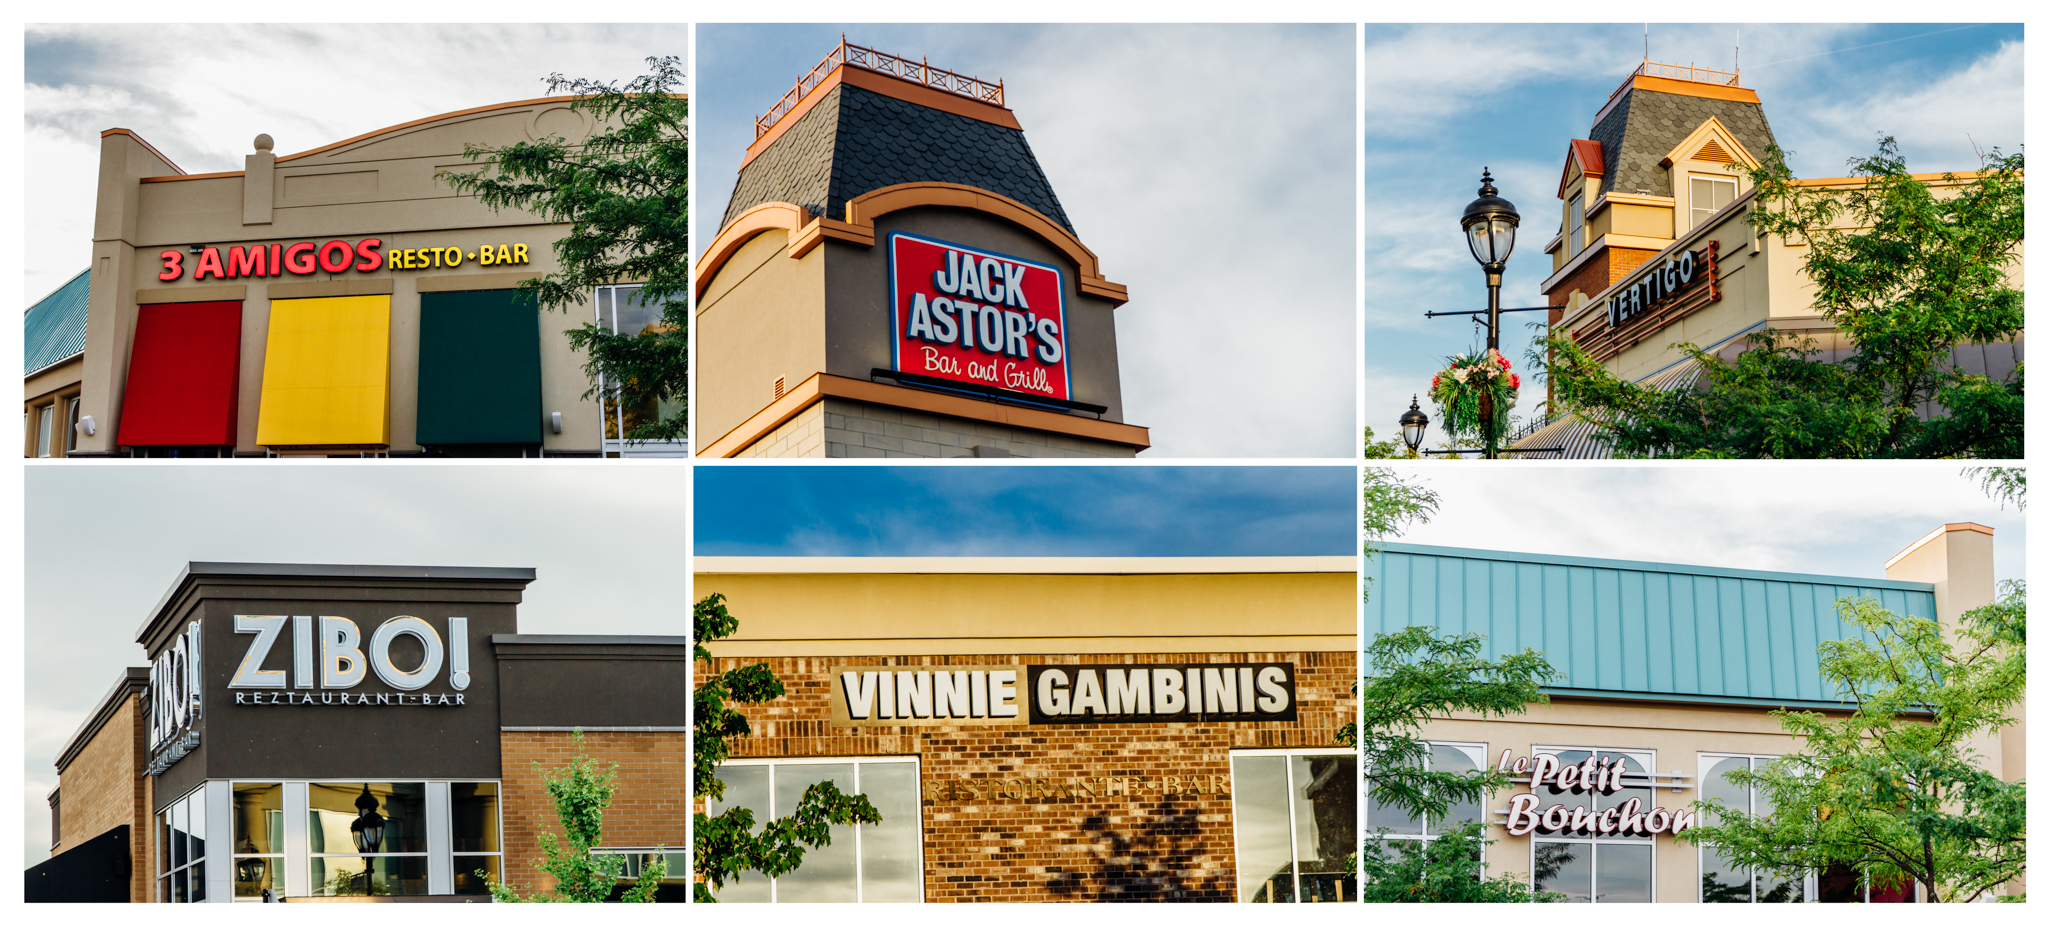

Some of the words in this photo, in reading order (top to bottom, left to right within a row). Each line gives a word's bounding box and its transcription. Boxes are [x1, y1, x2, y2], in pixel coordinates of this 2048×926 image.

[158, 250, 184, 282] 3
[193, 238, 384, 281] AMIGOS
[388, 245, 463, 270] RESTO
[480, 242, 530, 266] BAR
[933, 250, 1030, 310] JACK
[1607, 249, 1700, 328] VERTIGO
[906, 292, 1063, 365] ASTOR'S
[920, 346, 962, 376] Bar
[968, 359, 999, 383] and
[227, 613, 472, 692] ZIBO!
[841, 670, 1019, 720] VINNIE
[1037, 666, 1290, 717] GAMBINIS
[925, 775, 1143, 802] RISTORANTE
[1161, 773, 1231, 796] BAR
[1498, 748, 1528, 774] Le
[1529, 752, 1627, 793] Petit
[1506, 793, 1696, 837] Bouchon
